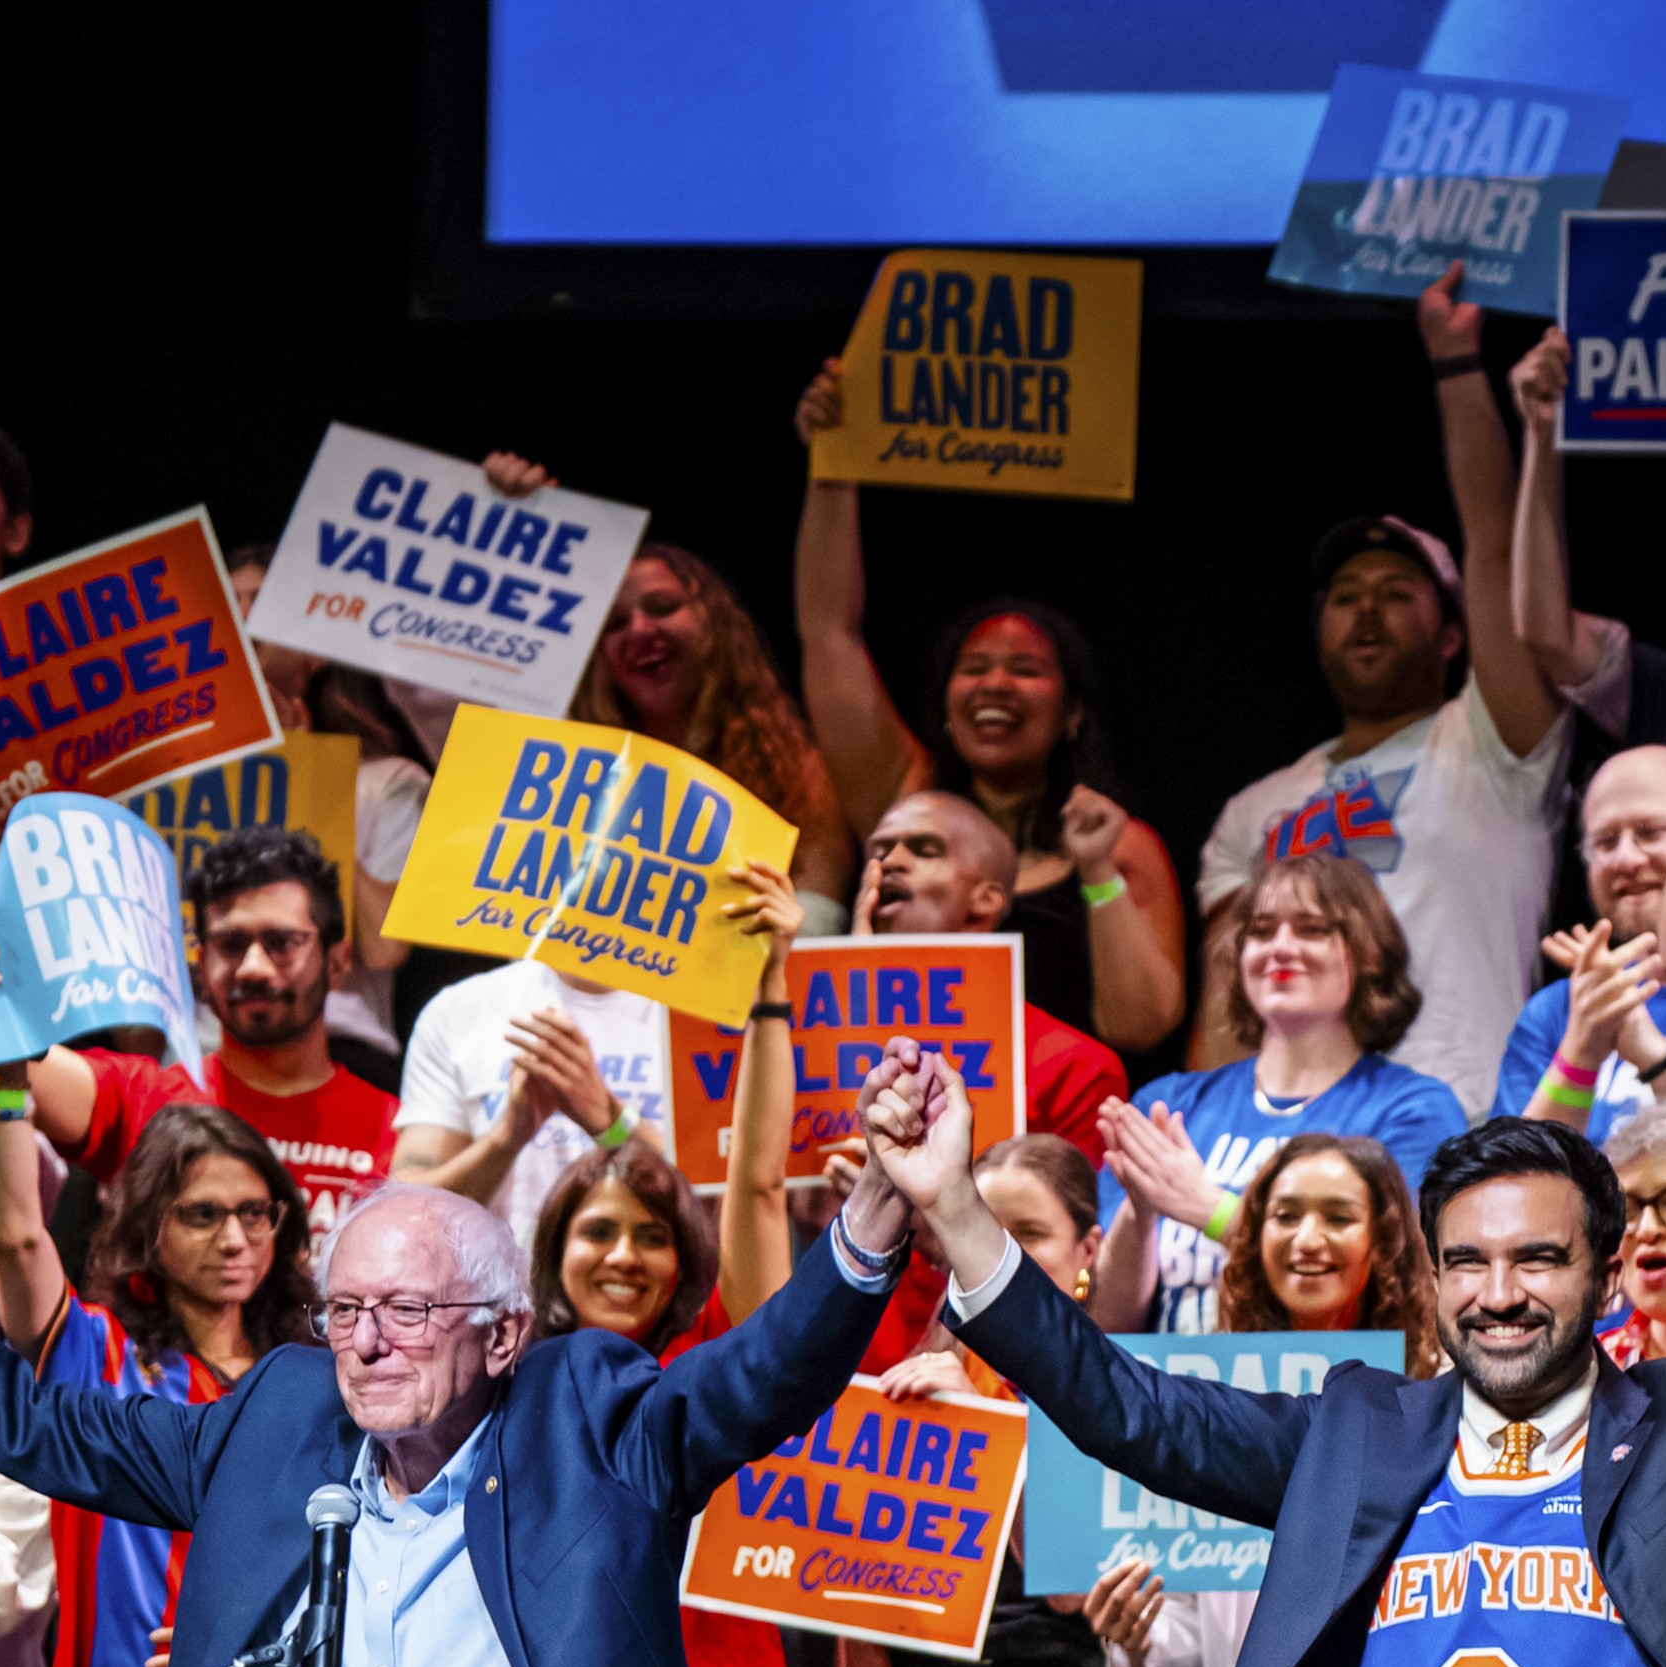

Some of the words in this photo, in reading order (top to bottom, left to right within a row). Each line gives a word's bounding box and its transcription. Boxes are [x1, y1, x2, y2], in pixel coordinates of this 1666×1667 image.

[1379, 88, 1569, 182] BRAD
[1354, 175, 1539, 253] LANDER
[883, 270, 1074, 361] BRAD
[880, 355, 1070, 436] LANDER
[880, 431, 930, 463] for
[937, 433, 1063, 475] Congress
[354, 467, 587, 575] CLAIRE
[316, 522, 584, 634] VALDEZ
[307, 592, 366, 622] FOR
[369, 603, 544, 664] CONGRESS
[53, 683, 215, 786] CONGRESS
[145, 755, 288, 831] RAD
[500, 739, 733, 866] BRAD
[6, 809, 172, 930] BRAD
[474, 823, 706, 945] LANDER
[456, 898, 517, 930] for
[524, 906, 678, 978] Congress
[52, 973, 114, 1022] for
[716, 967, 964, 1036] AIRE
[734, 1466, 990, 1561] VALDEZ
[1543, 1501, 1574, 1514] abu
[734, 1546, 792, 1578] FOR
[799, 1549, 964, 1599] CONGRESS
